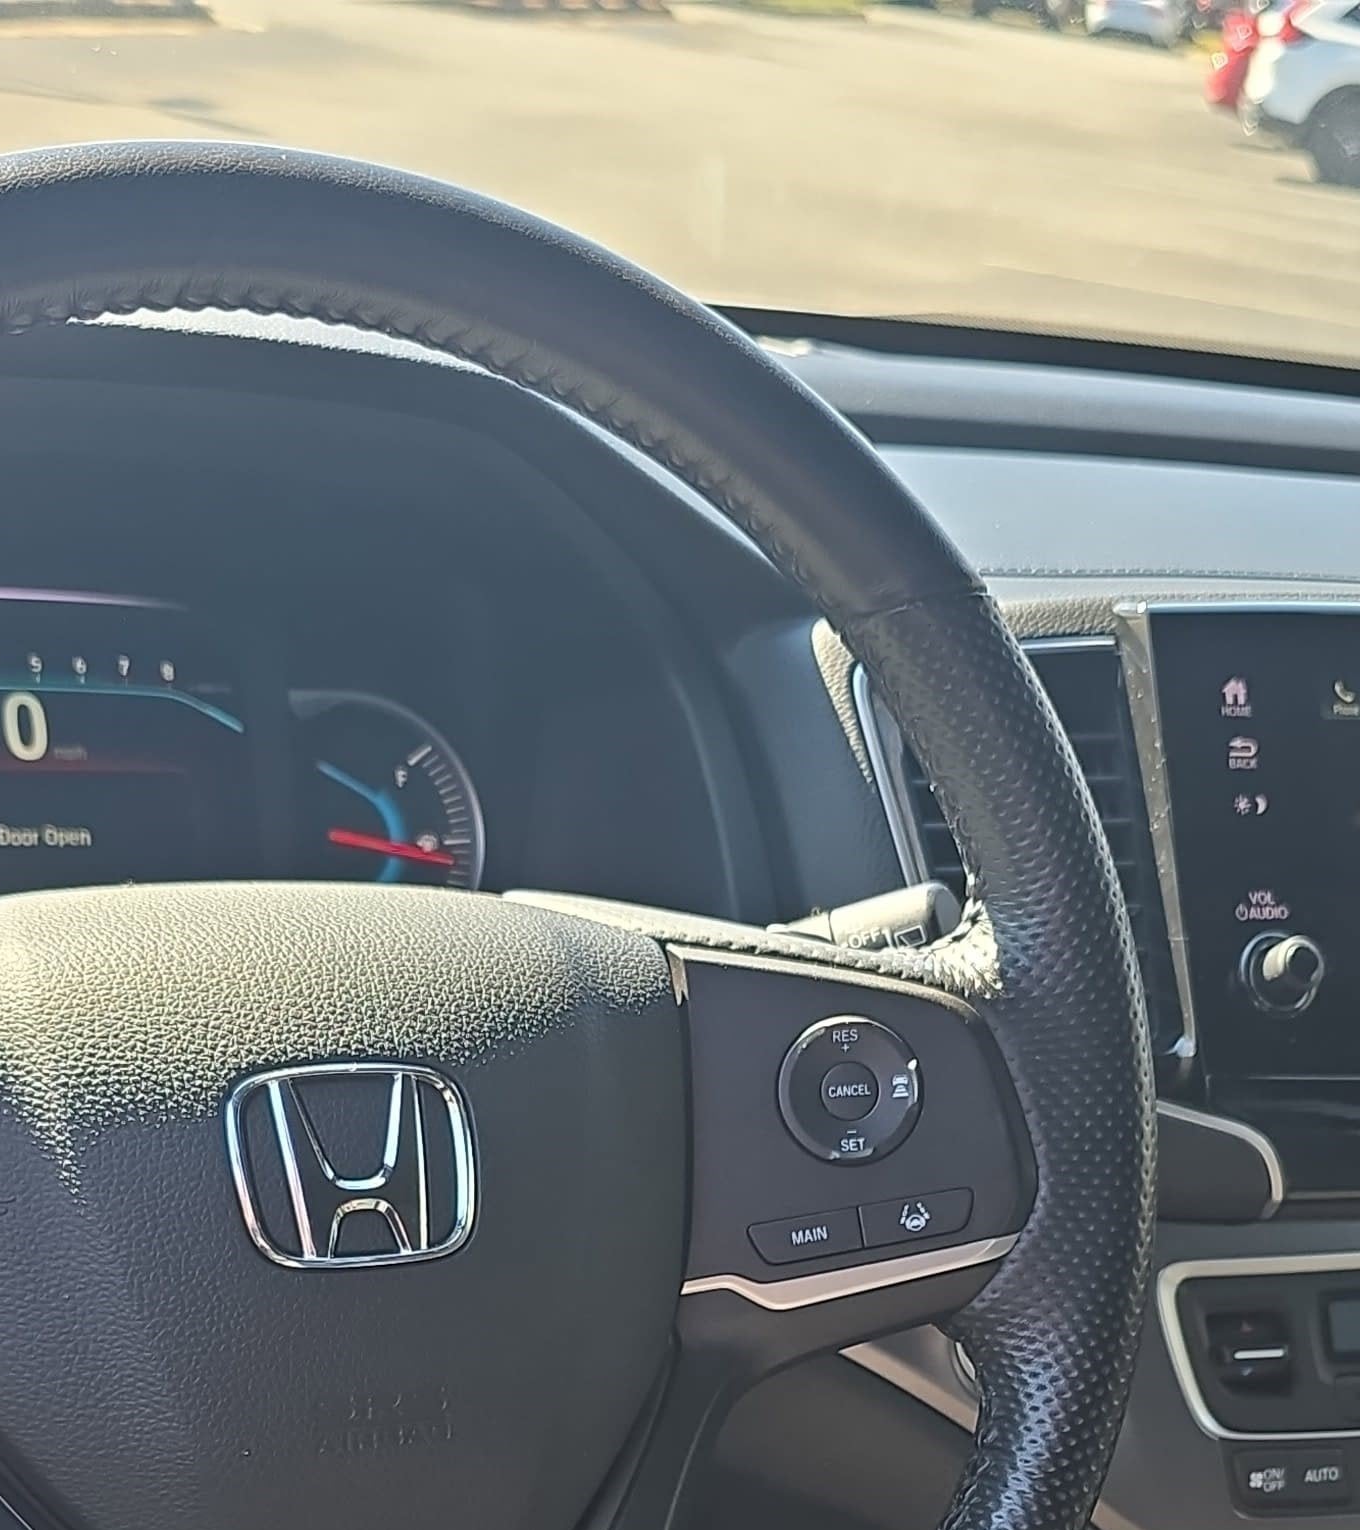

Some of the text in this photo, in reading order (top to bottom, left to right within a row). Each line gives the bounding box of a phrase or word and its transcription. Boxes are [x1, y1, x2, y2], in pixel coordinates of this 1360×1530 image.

[27, 653, 42, 673] 5
[72, 655, 87, 675] 6
[1221, 704, 1252, 718] HOME
[1, 690, 49, 761] 0
[1228, 757, 1258, 770] BACK
[394, 766, 408, 788] F
[42, 824, 93, 849] Open
[1248, 891, 1276, 906] VOL
[1248, 905, 1290, 921] AUDIO
[848, 926, 880, 949] OFF
[832, 1028, 859, 1044] RES
[828, 1083, 872, 1099] CANCEL
[840, 1137, 866, 1152] SET
[790, 1226, 829, 1247] MAIN
[1304, 1466, 1340, 1483] AUTO
[1263, 1480, 1285, 1493] OFF
